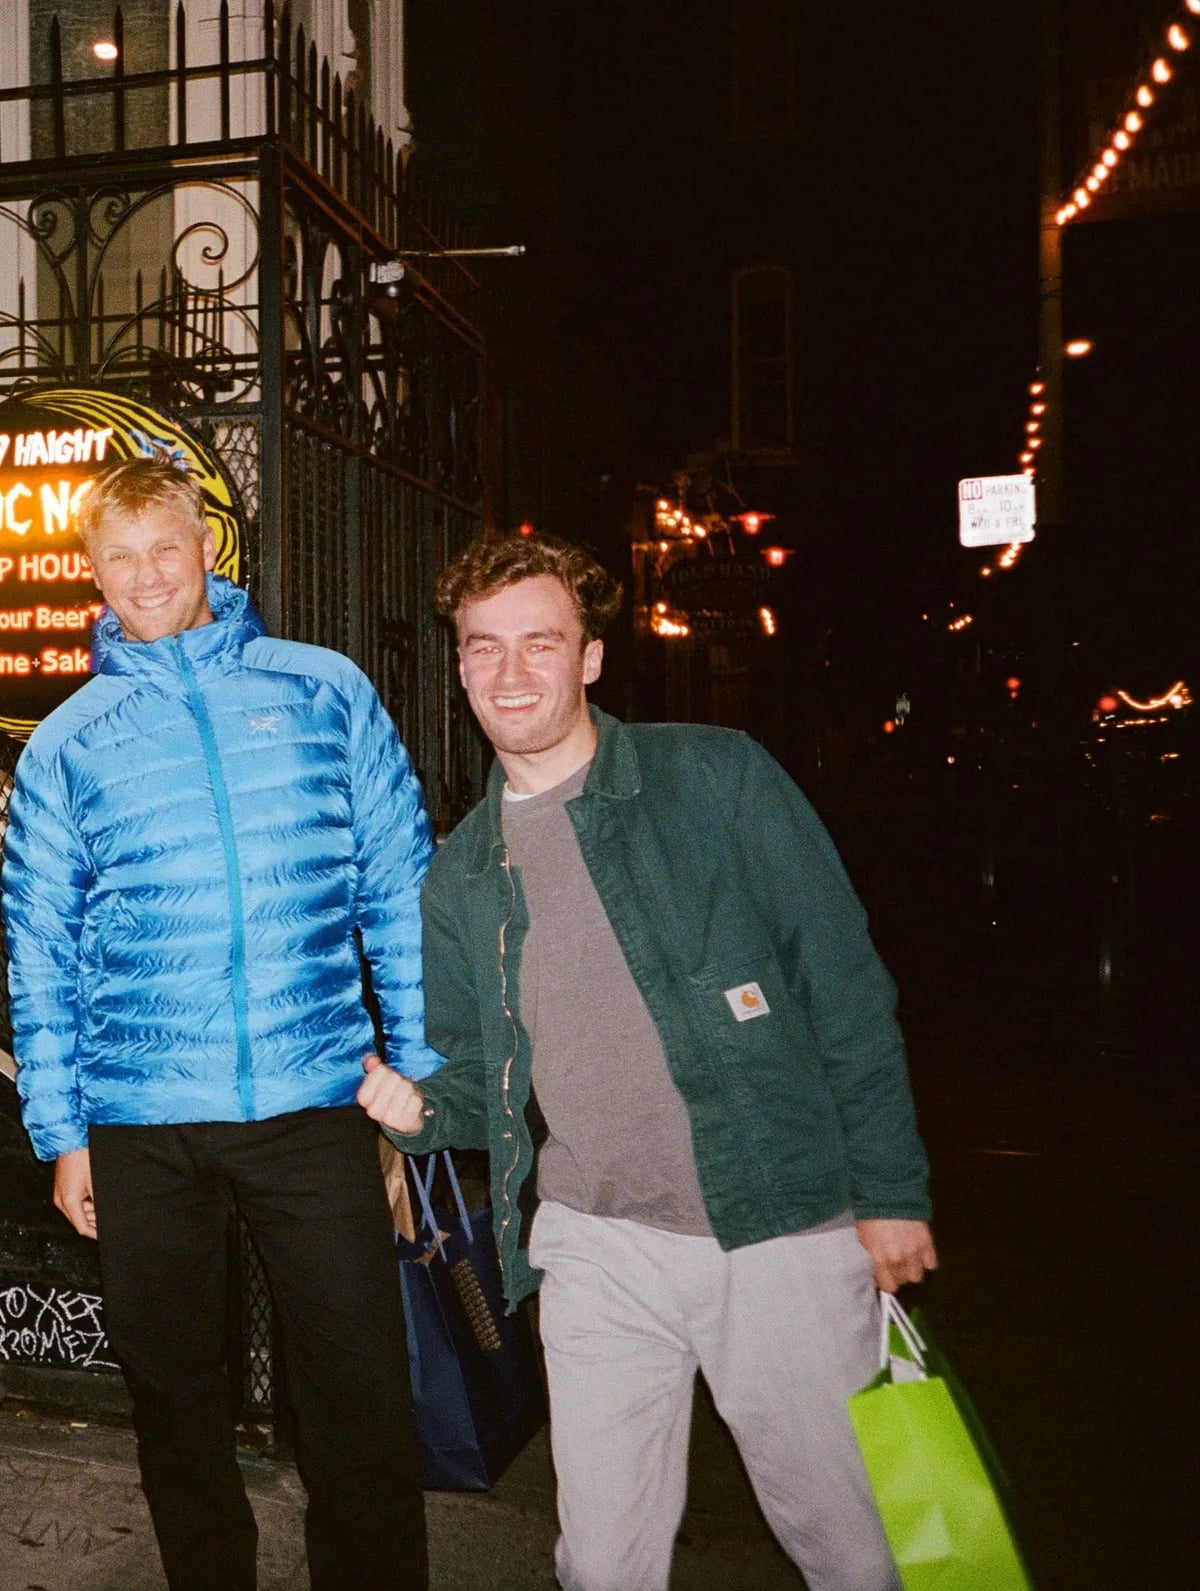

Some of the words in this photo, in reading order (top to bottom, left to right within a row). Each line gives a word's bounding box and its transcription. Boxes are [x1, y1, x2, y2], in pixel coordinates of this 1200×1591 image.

[14, 428, 113, 466] HAIGHT
[20, 554, 93, 580] HOUS
[36, 607, 89, 628] Beer
[43, 649, 90, 672] Sak
